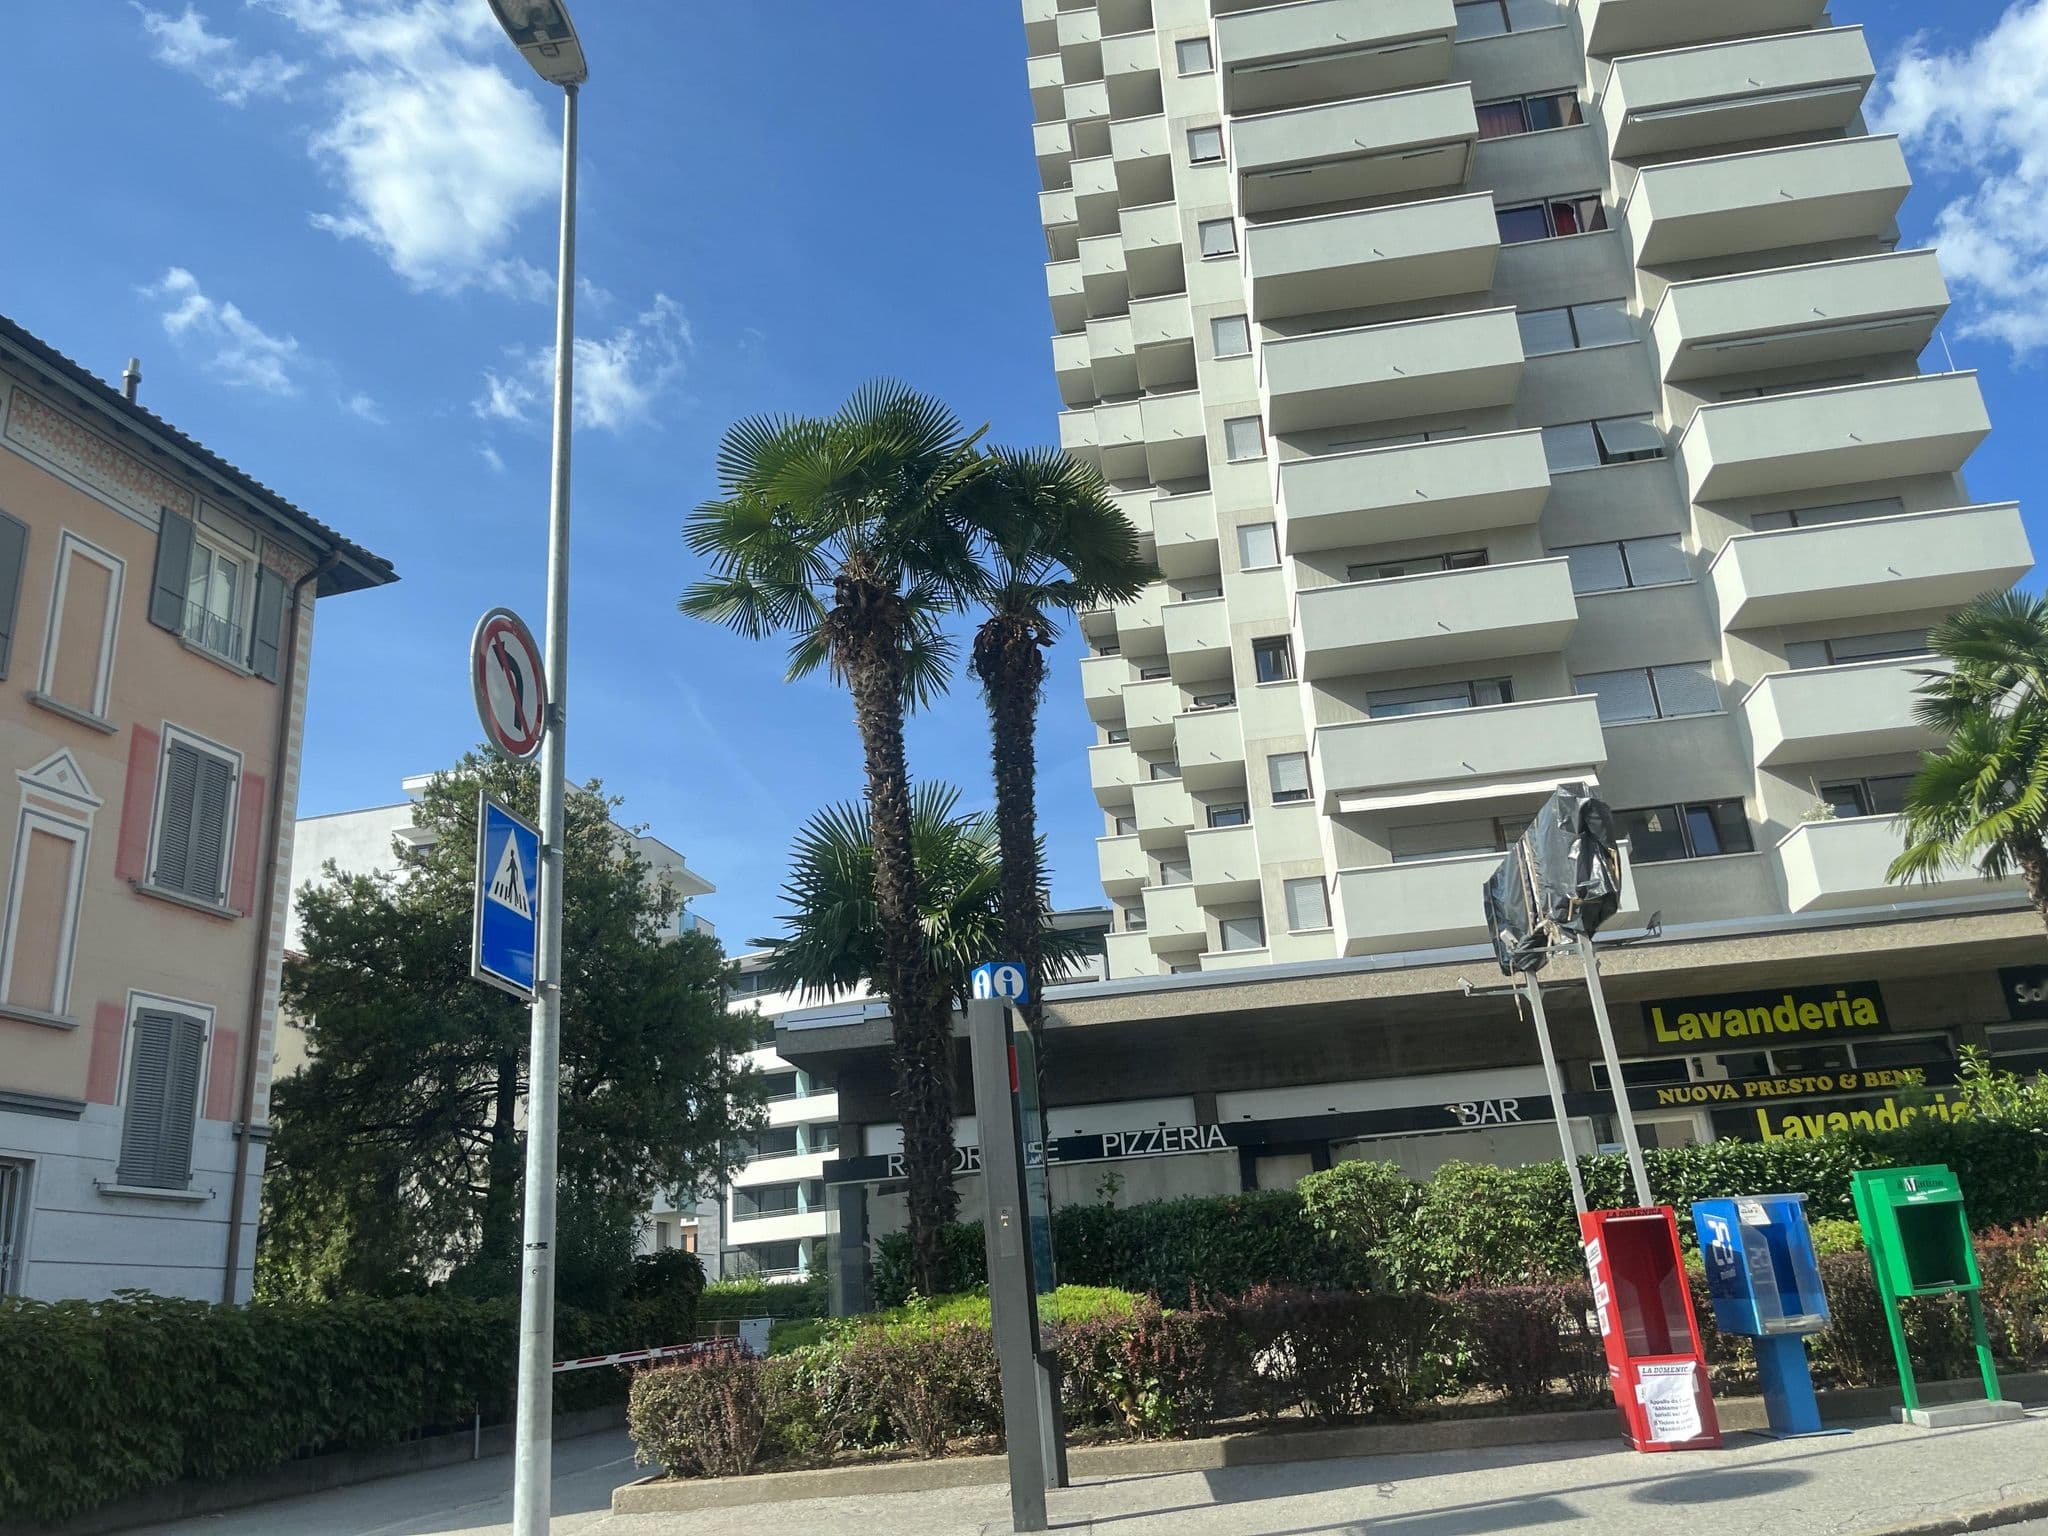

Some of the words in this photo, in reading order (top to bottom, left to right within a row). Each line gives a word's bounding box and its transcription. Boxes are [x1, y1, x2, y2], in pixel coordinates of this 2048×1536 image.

[1651, 990, 1879, 1043] Lavanderia
[1657, 1082, 1740, 1105] NUOVA
[1743, 1074, 1834, 1099] PRESTO
[1839, 1073, 1858, 1089] &
[1461, 1097, 1522, 1127] BAR
[1101, 1123, 1227, 1159] PIZZERIA
[1619, 1207, 1663, 1217] DOMENICA
[1654, 1366, 1689, 1374] DOMENIC
